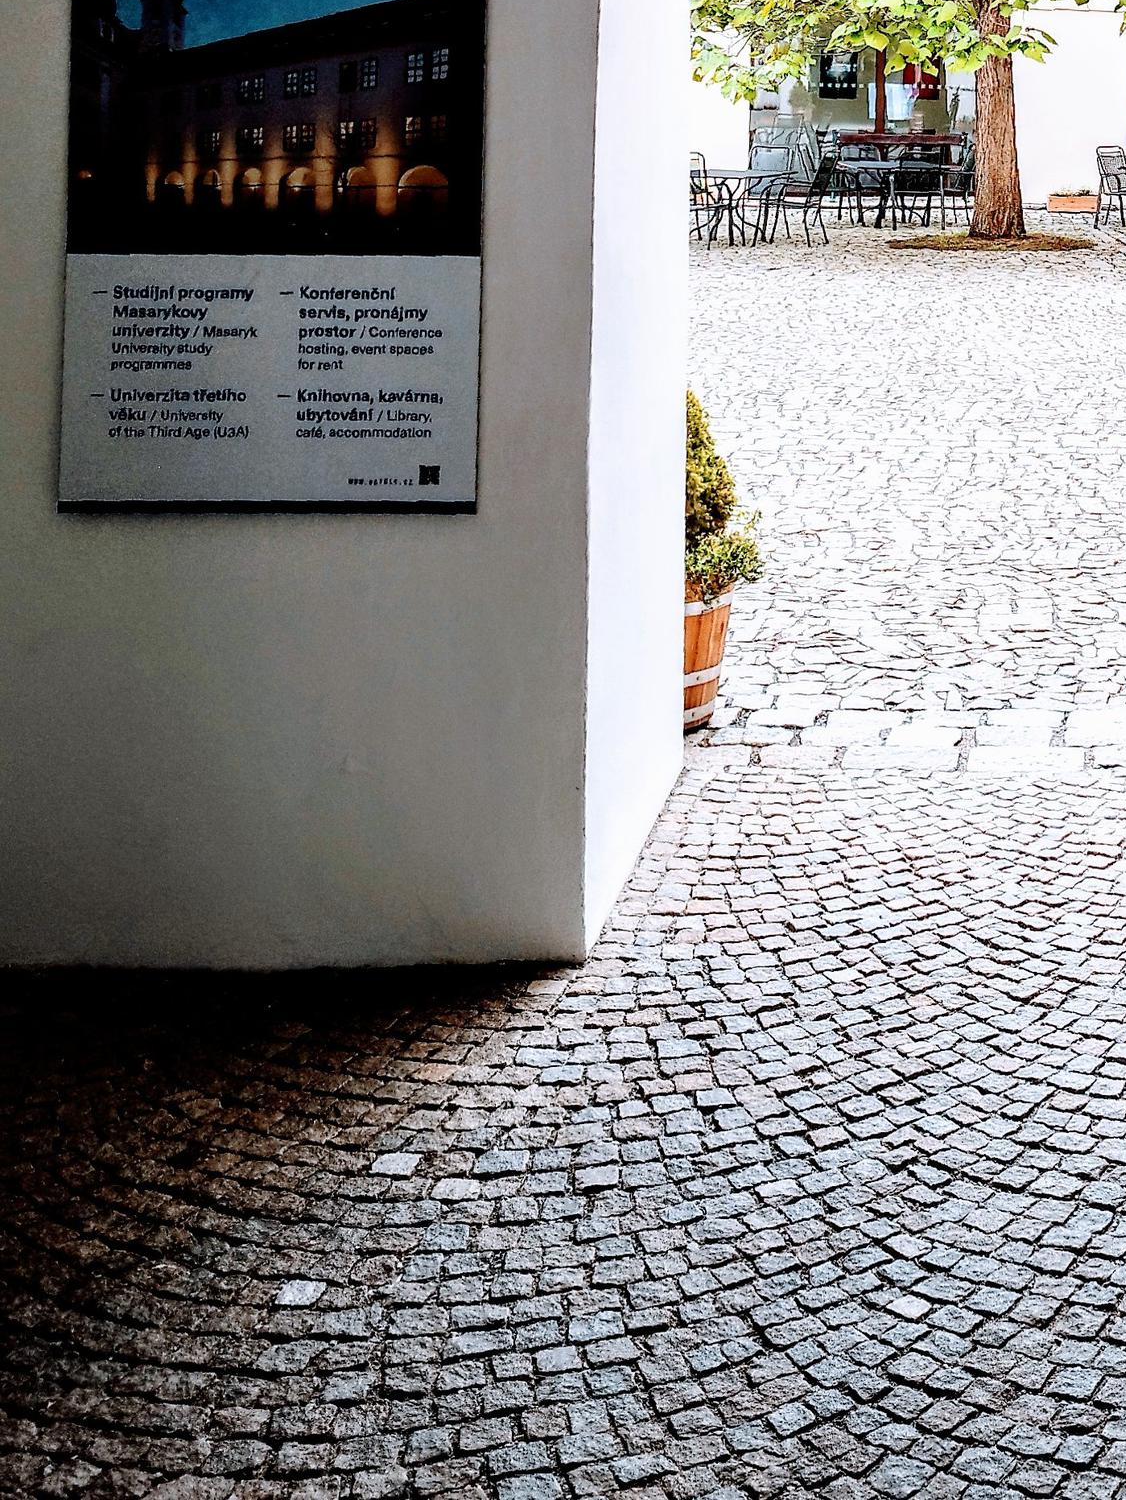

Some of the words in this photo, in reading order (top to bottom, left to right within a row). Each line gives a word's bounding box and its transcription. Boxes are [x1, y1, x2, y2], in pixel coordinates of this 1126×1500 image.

[113, 285, 174, 301] Studijní
[178, 287, 254, 302] programy
[299, 285, 396, 300] Konferenční
[113, 304, 208, 320] Masarykovy
[299, 305, 351, 321] servis,
[354, 306, 428, 322] pronájmy
[112, 324, 190, 339] univerzity
[203, 326, 258, 339] Masaryk
[299, 326, 356, 340] prostor
[368, 326, 443, 338] Conference
[111, 342, 175, 356] University
[177, 343, 213, 356] study
[298, 343, 348, 356] hosting,
[351, 345, 386, 355] event
[389, 345, 434, 356] spaces
[110, 360, 192, 372] programmes
[297, 359, 315, 370] for
[317, 360, 344, 371] rent
[110, 388, 190, 403] Univerzita
[193, 389, 246, 403] třetího
[297, 389, 374, 405] Knihovna,
[378, 389, 444, 405] kavárna,
[108, 408, 146, 421] věku
[161, 409, 224, 423] University
[296, 408, 373, 424] ubytování
[387, 410, 432, 424] Library,
[108, 426, 121, 438] of
[124, 426, 145, 438] the
[149, 426, 181, 438] Third
[183, 427, 210, 440] Age
[213, 425, 249, 439] (U3A)
[296, 427, 326, 439] café,
[329, 427, 432, 439] accommodation
